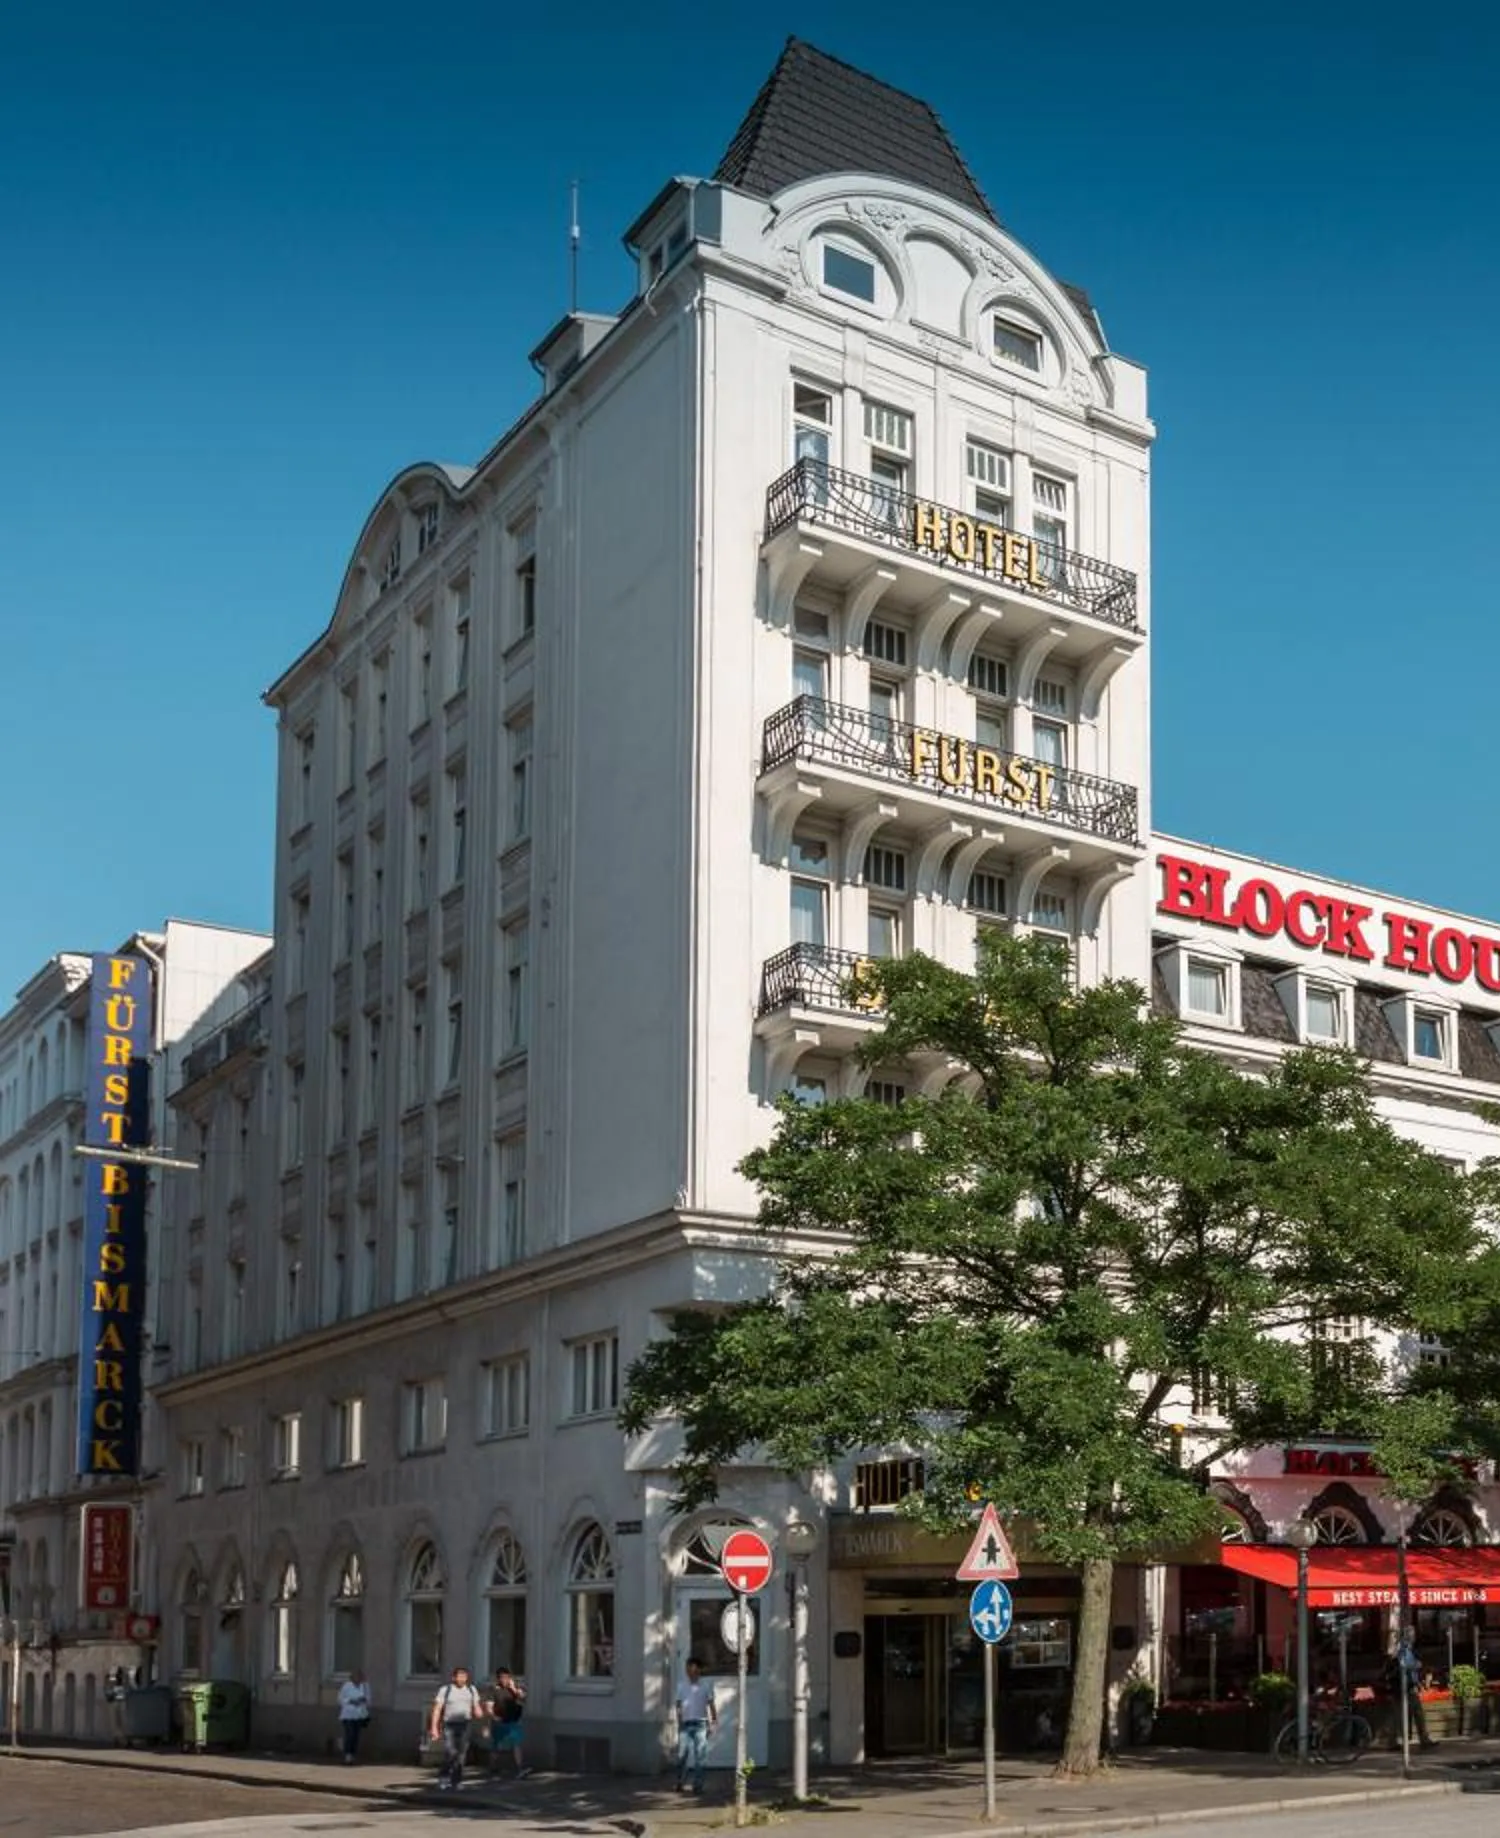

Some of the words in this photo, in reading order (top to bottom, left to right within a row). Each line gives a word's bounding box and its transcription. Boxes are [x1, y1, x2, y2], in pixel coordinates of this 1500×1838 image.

[914, 502, 1049, 588] HOTEL
[1157, 853, 1375, 961] BLOCK
[102, 958, 136, 1145] FÜRST
[92, 1164, 130, 1471] BISMARCK
[1333, 1590, 1362, 1605] BEST
[1367, 1589, 1417, 1604] STEAS
[1419, 1590, 1459, 1604] SINCE
